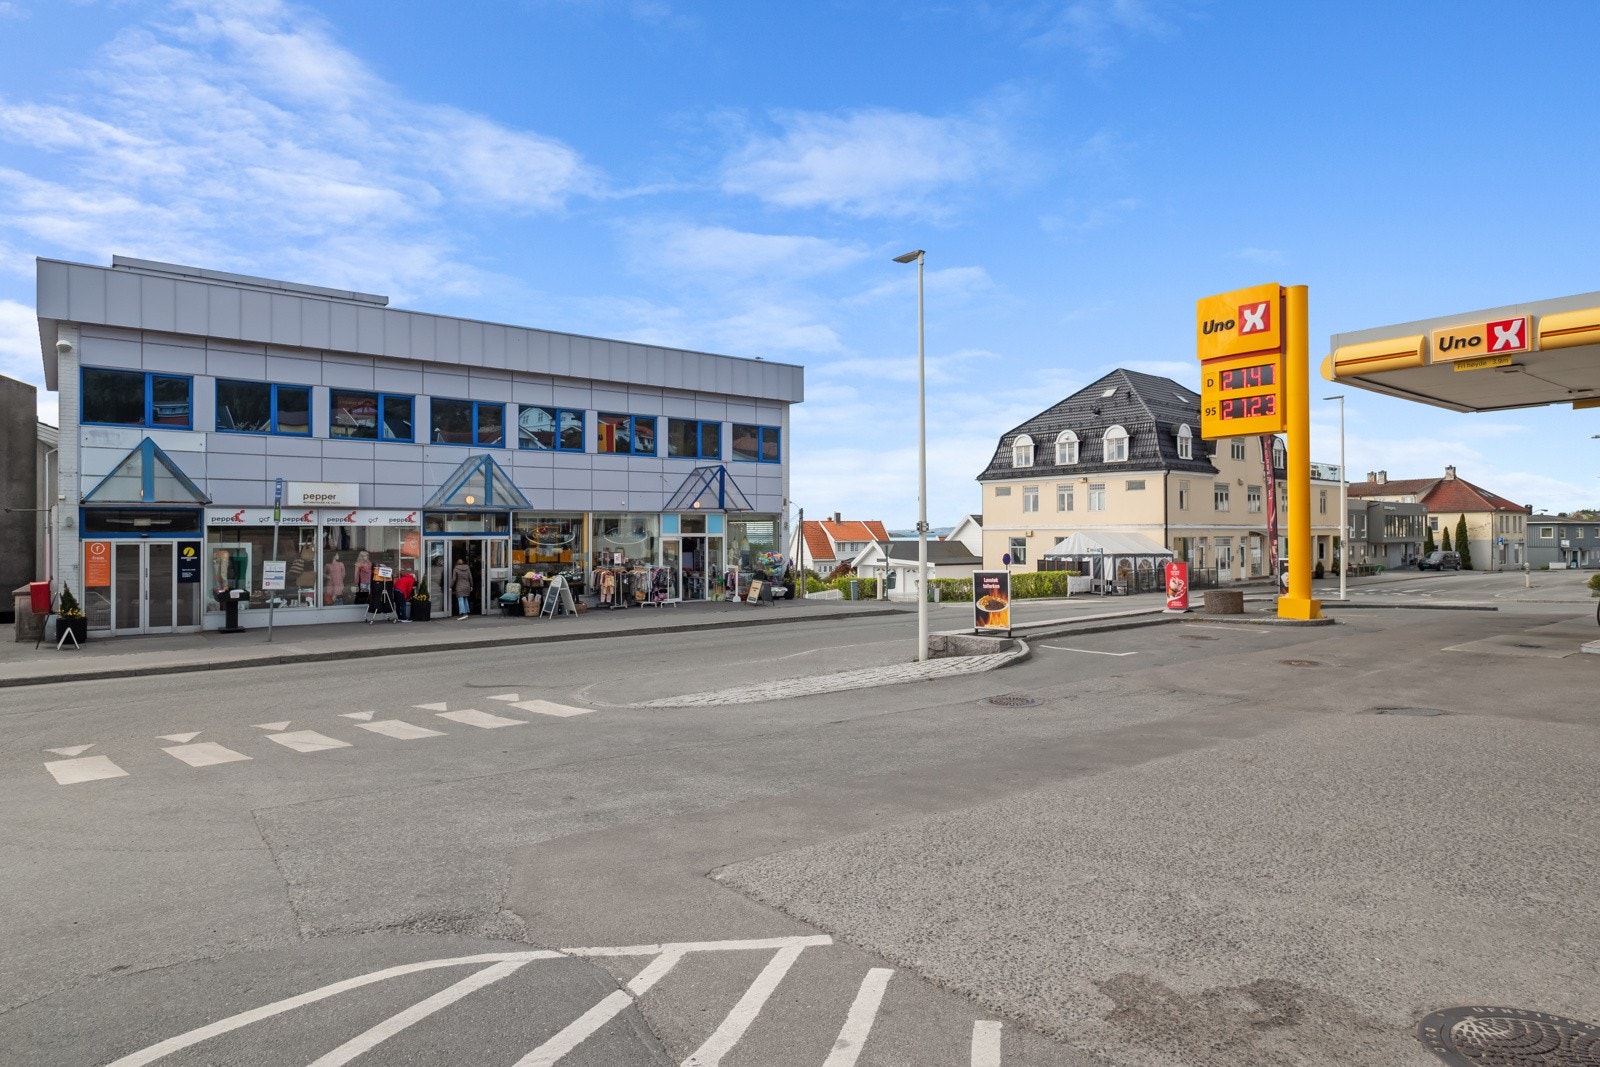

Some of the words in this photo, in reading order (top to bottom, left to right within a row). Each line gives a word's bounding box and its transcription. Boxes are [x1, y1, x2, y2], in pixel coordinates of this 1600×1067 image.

[1202, 319, 1235, 335] Uno
[1242, 303, 1267, 333] X
[1438, 336, 1482, 352] Uno
[1492, 319, 1523, 350] X
[1207, 378, 1214, 388] D
[1222, 364, 1275, 391] 21.41
[1205, 406, 1216, 417] 95
[1222, 394, 1276, 420] 21.23
[303, 493, 337, 501] pepper
